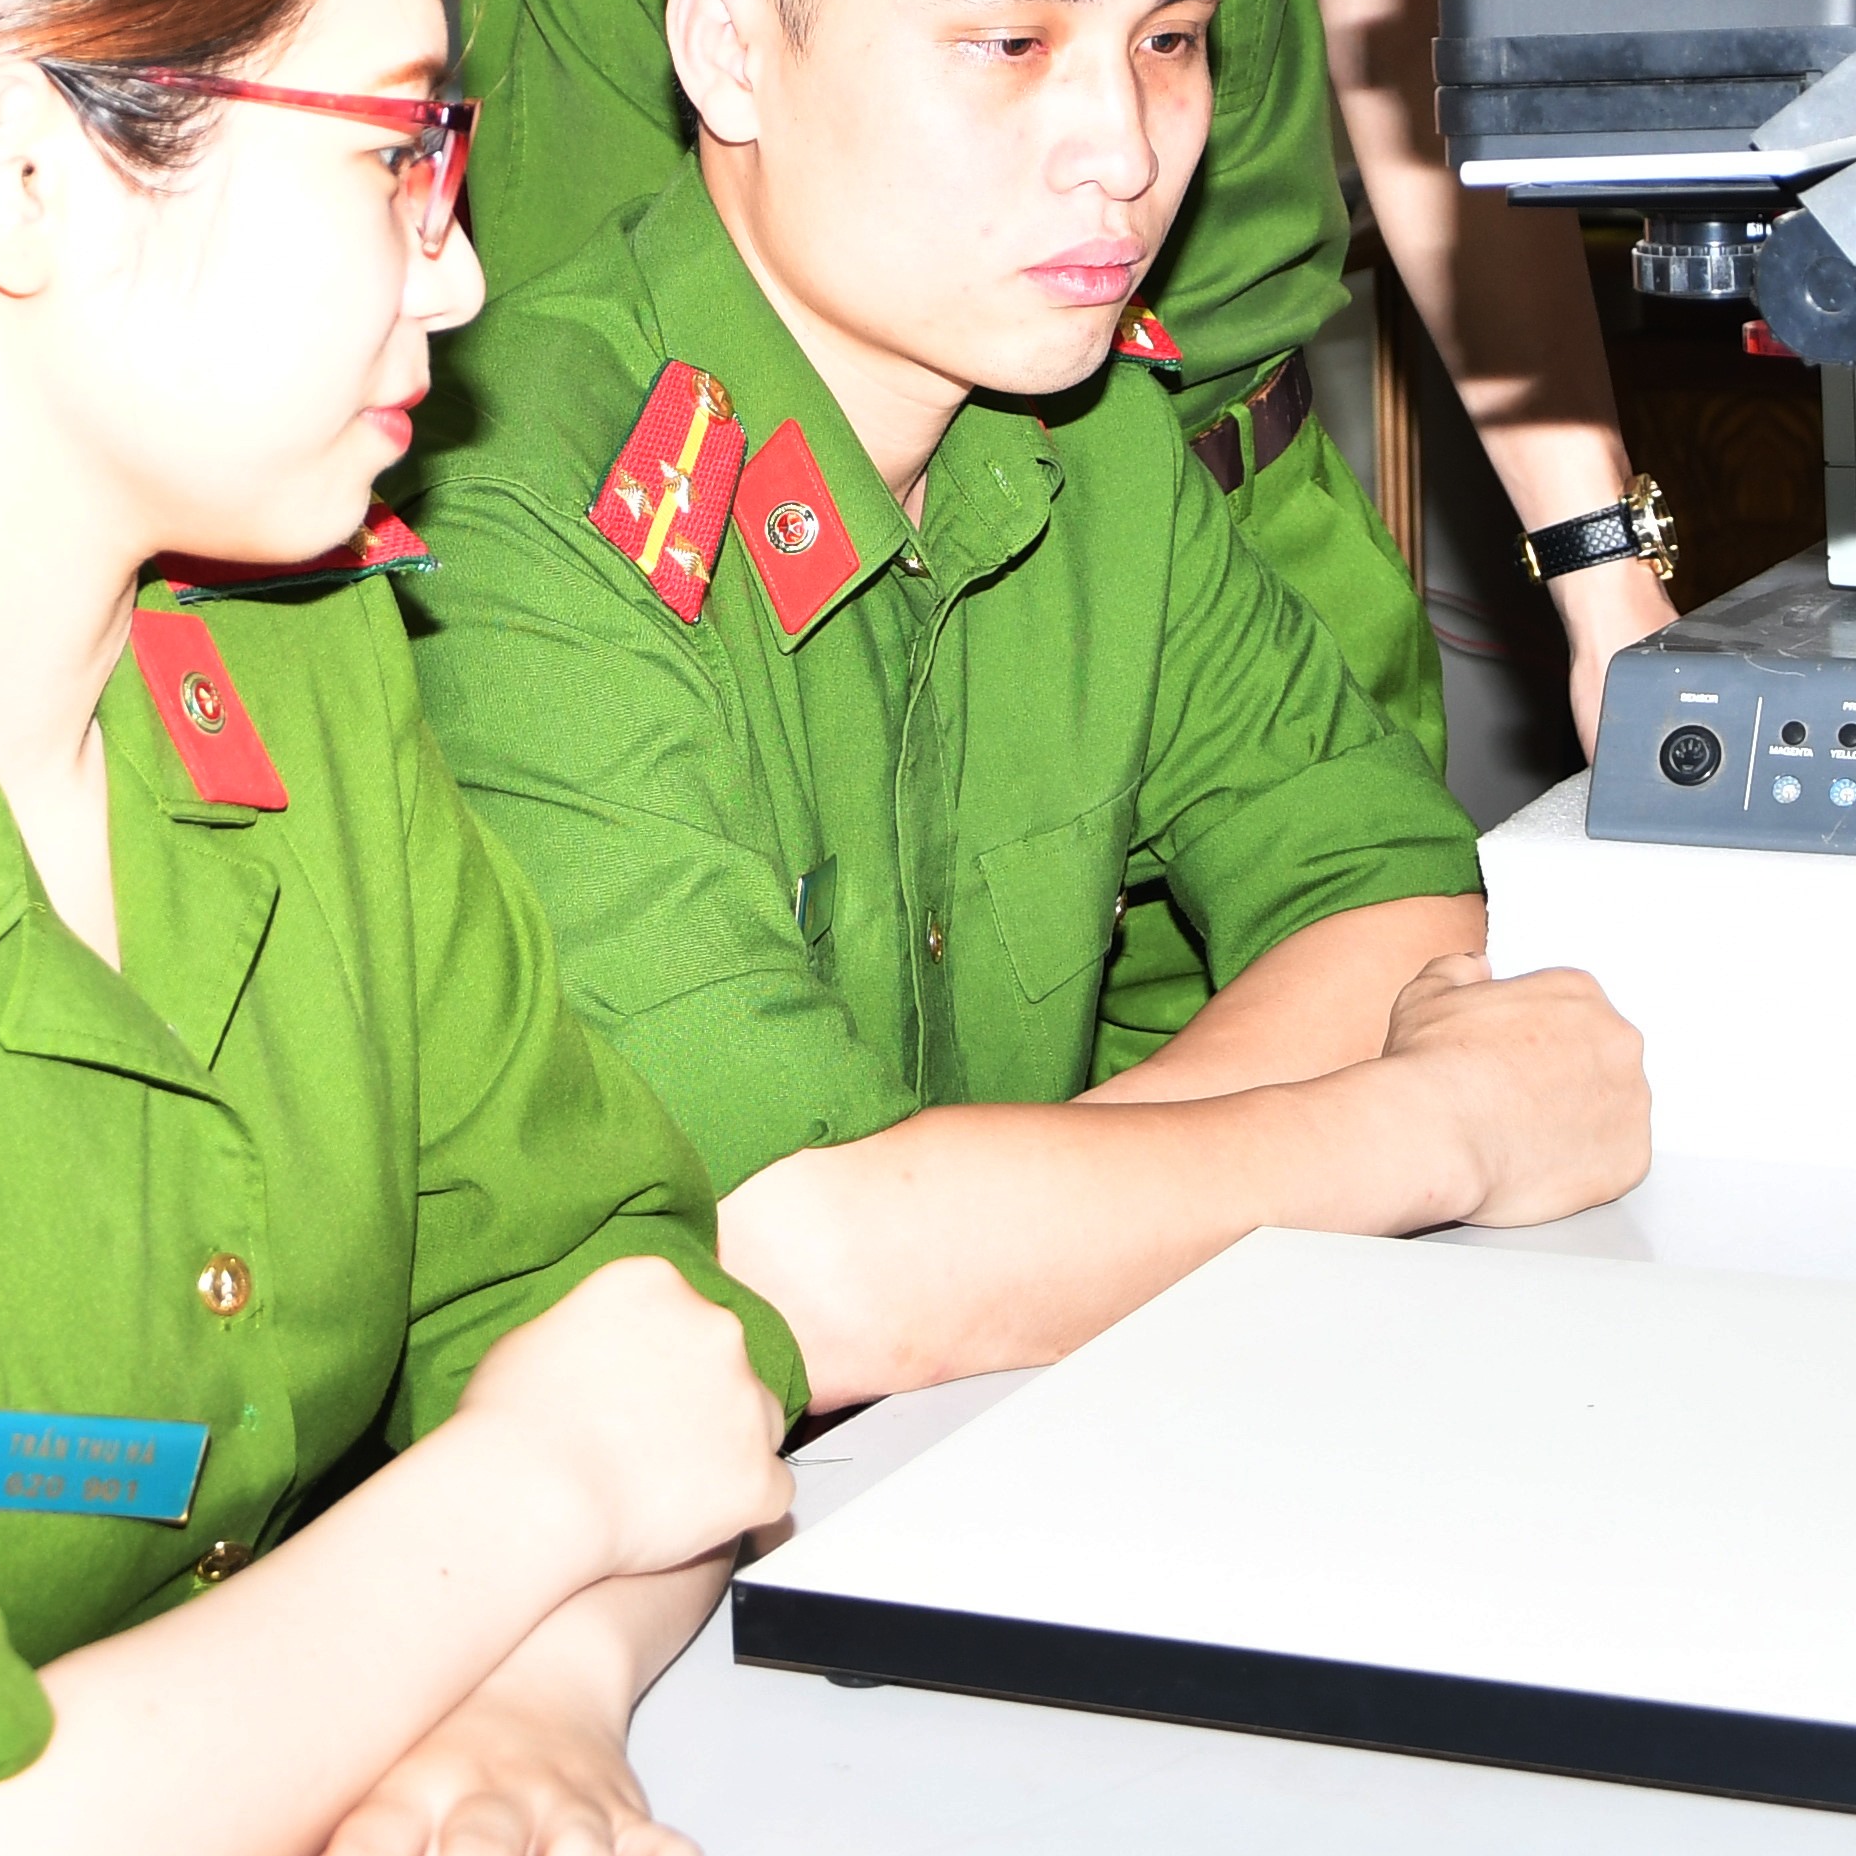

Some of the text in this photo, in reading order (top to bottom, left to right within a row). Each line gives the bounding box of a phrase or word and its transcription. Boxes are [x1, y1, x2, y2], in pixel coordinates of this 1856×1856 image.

[1680, 692, 1719, 704] SENSOR
[1769, 745, 1814, 758] MAGENTA
[4, 1473, 139, 1502] 620 901
